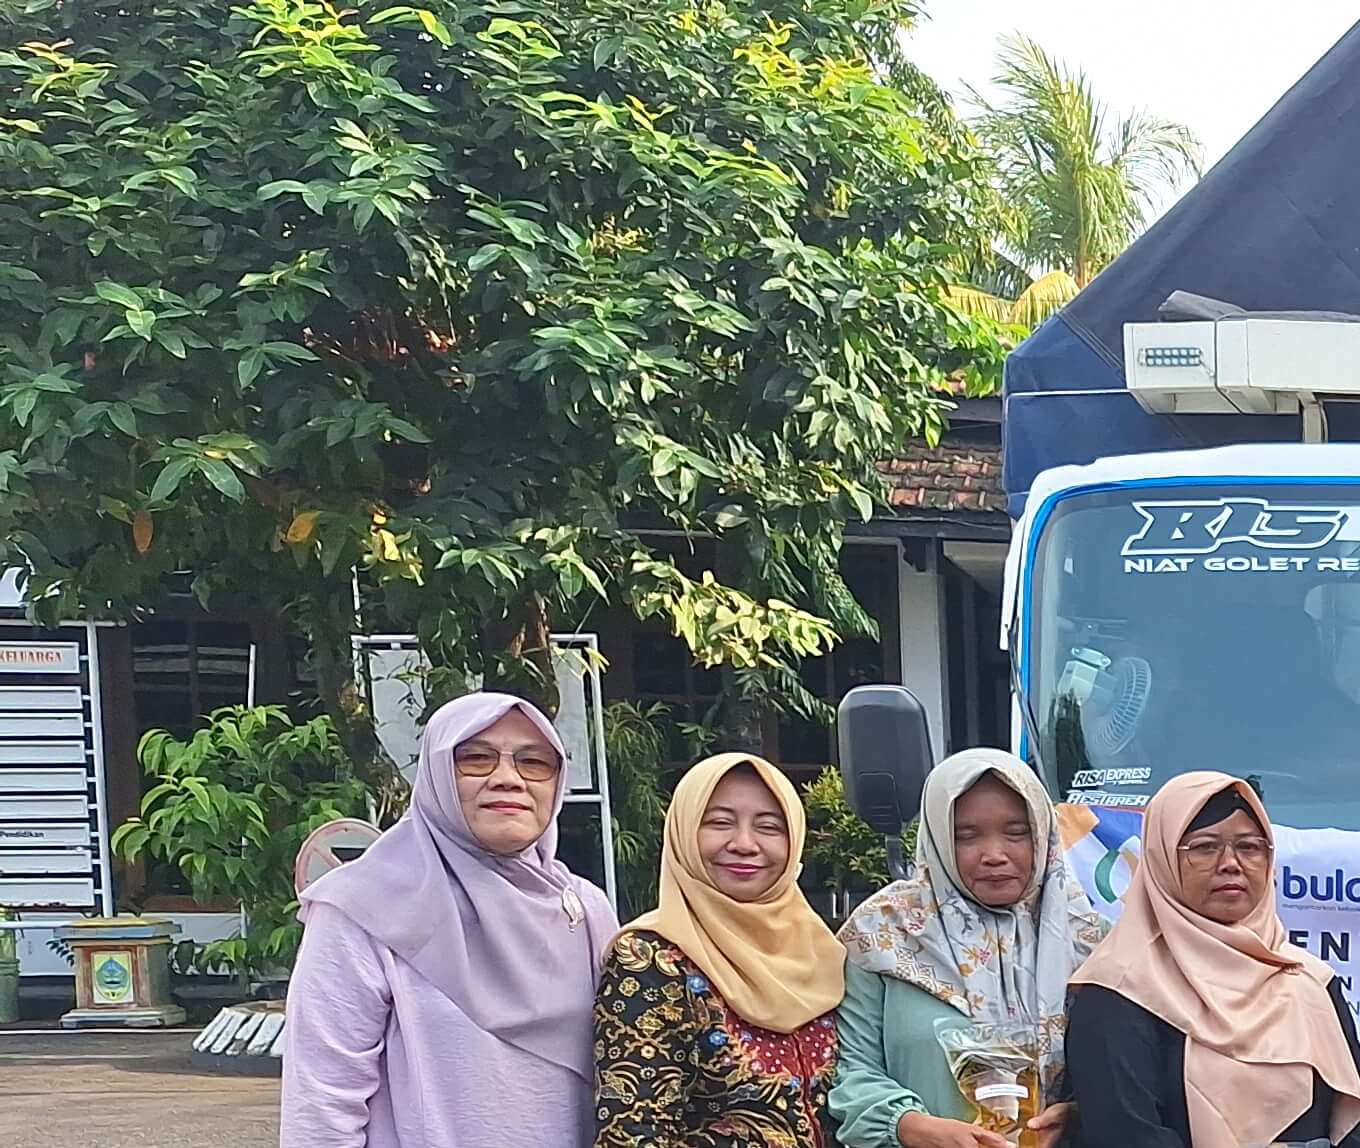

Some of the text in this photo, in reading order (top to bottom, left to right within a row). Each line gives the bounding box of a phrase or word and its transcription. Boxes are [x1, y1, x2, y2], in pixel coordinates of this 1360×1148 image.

[1124, 558, 1194, 573] NIAT
[1203, 558, 1310, 572] GOLET
[1107, 768, 1151, 781] EXPRESS
